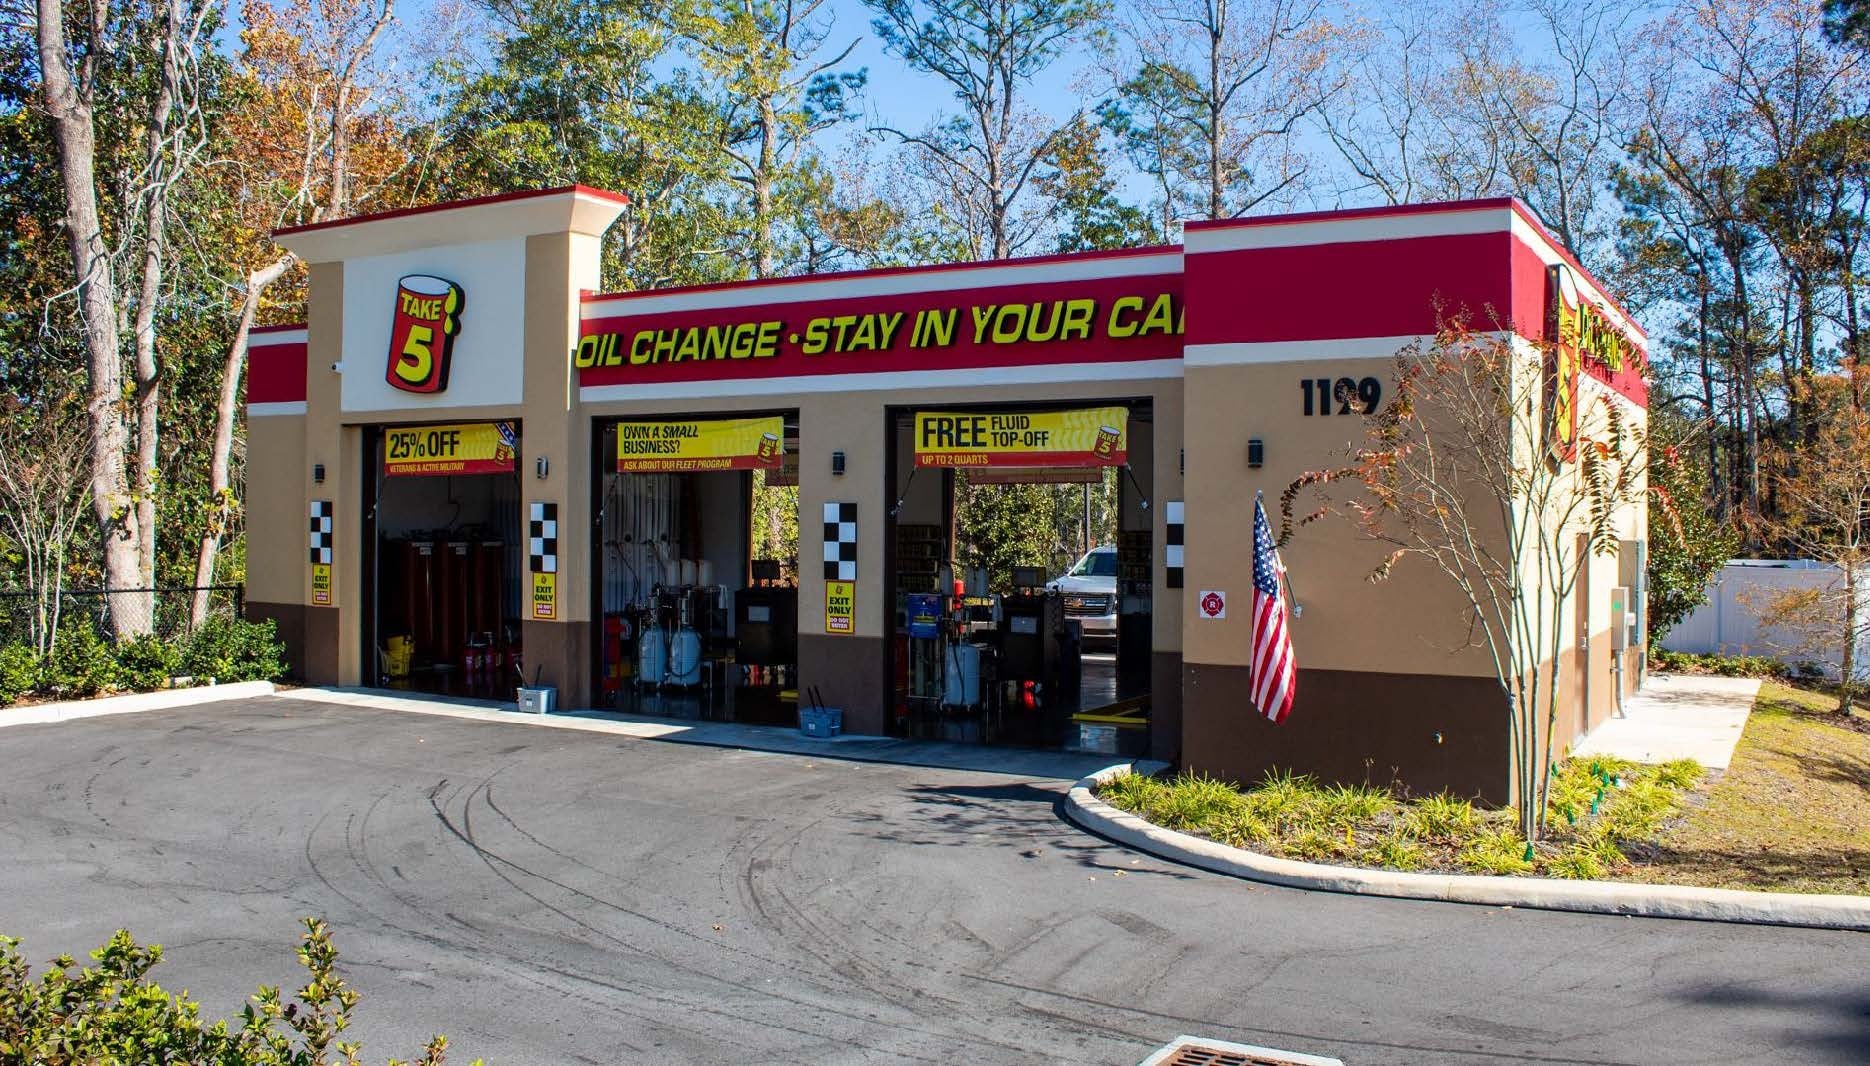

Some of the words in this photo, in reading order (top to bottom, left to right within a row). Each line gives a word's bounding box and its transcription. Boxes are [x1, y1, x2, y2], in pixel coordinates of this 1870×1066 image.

[400, 292, 441, 321] TAKE
[575, 333, 623, 368] OIL
[630, 321, 781, 365] CHANGE
[803, 312, 903, 354] STAY
[910, 308, 956, 348] IN
[971, 298, 1095, 345] YOUR
[395, 324, 433, 384] 5
[624, 426, 649, 439] OWN
[652, 426, 660, 439] A
[663, 425, 698, 438] SMALL
[922, 416, 986, 447] FREE
[991, 416, 1030, 430] FLUID
[390, 432, 425, 459] 25%
[427, 430, 460, 457] OFF
[991, 431, 1049, 447] TOP-OFF
[624, 440, 680, 454] BUSINESS?
[1098, 441, 1111, 454] 5
[624, 462, 637, 470] ASK
[638, 461, 660, 470] ABOUT
[662, 461, 674, 469] OUR
[676, 460, 696, 469] FLEET
[698, 459, 732, 468] PROGRAM
[922, 455, 933, 464] UP
[935, 455, 946, 464] TO
[947, 455, 952, 464] 2
[954, 454, 989, 464] QUARTS
[440, 462, 465, 471] MILITARY
[829, 597, 849, 605] EXIT
[828, 606, 851, 614] ONLY
